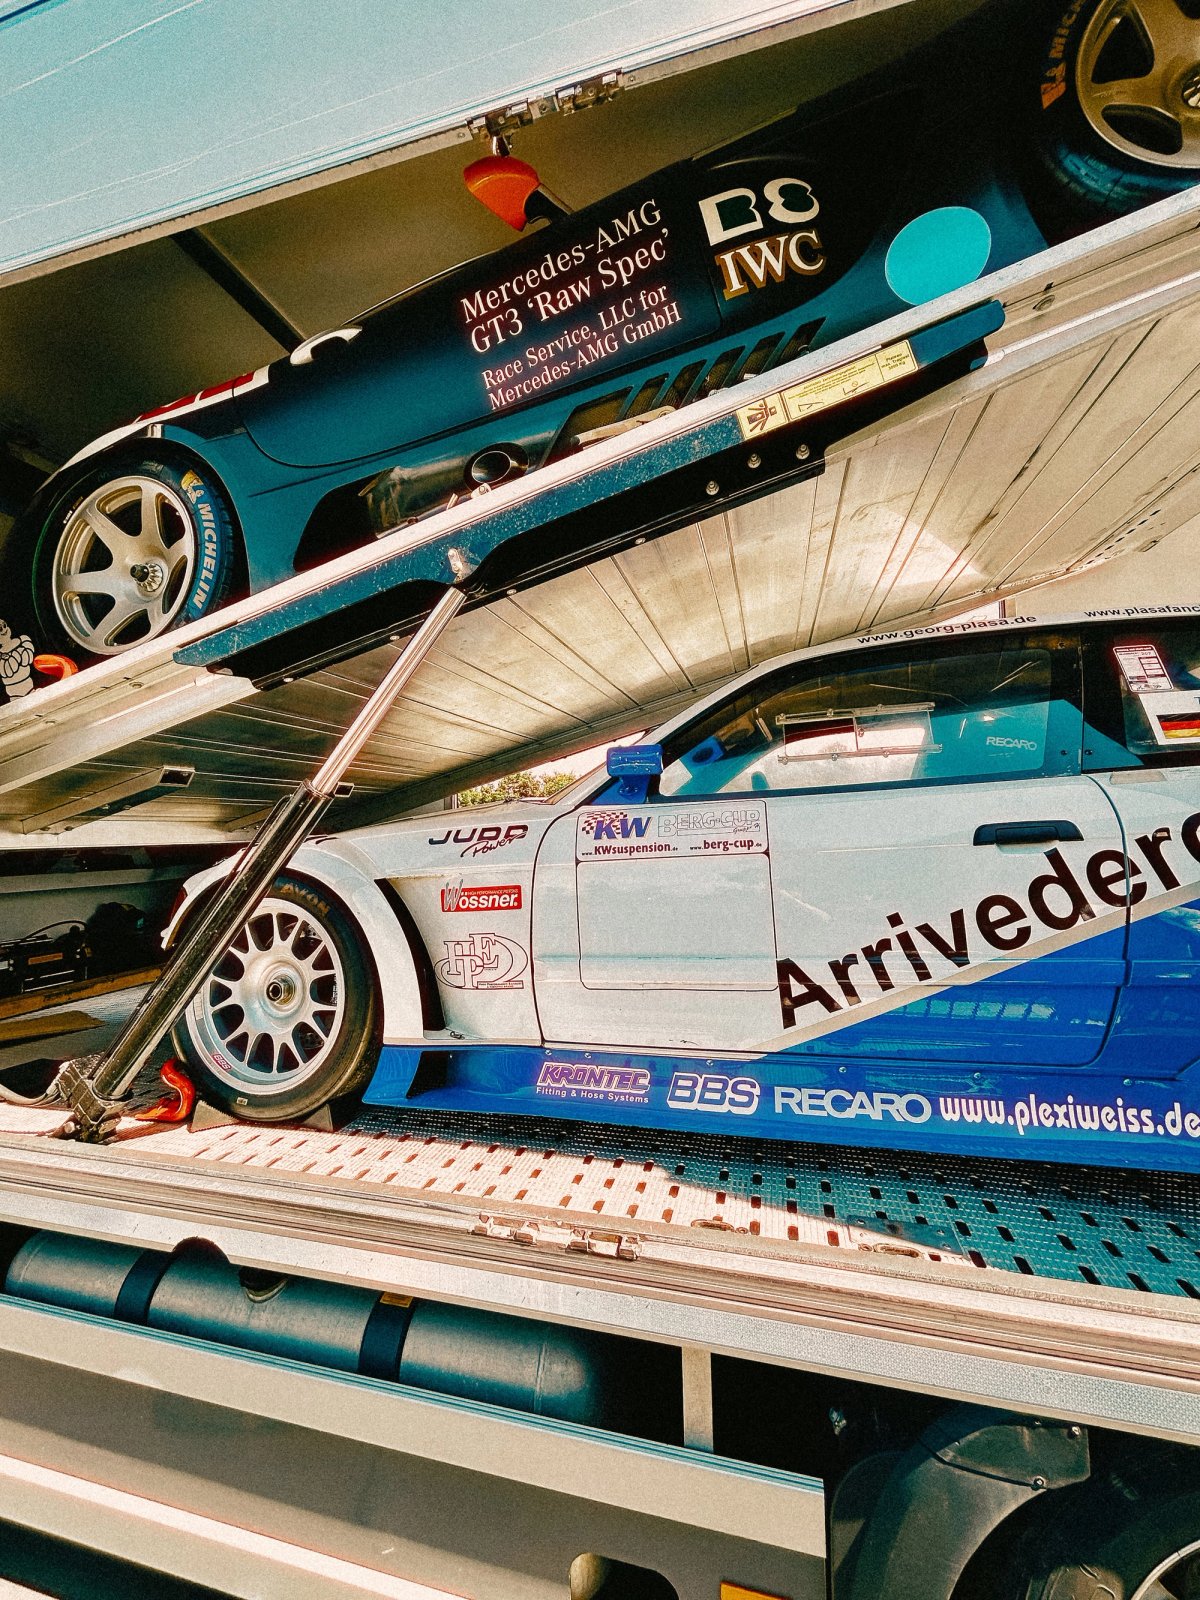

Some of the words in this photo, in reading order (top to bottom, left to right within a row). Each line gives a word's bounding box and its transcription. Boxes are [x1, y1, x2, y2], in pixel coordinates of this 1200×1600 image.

[460, 198, 662, 324] Mercedes-AMG
[717, 229, 825, 297] IWC
[471, 307, 523, 354] GT3
[481, 358, 524, 390] Race
[525, 324, 598, 367] Service,
[597, 296, 636, 332] LLC
[638, 285, 668, 311] for
[488, 332, 619, 412] Mercedes-AMG
[622, 301, 683, 344] GmbH
[192, 503, 218, 610] MICHELIN
[857, 615, 1037, 644] www.georg-plasa.de
[986, 736, 1038, 751] RECARO
[428, 825, 529, 845] JUDD
[460, 831, 527, 857] Power
[593, 816, 652, 841] KW
[581, 842, 678, 857] www.KWsuspension.de
[690, 839, 762, 851] www.berg-cup.de
[280, 882, 331, 914] AVON
[537, 1062, 650, 1094] KRONTEC
[667, 1072, 760, 1115] BBS
[536, 1087, 567, 1098] Fitting
[580, 1091, 605, 1099] Hose
[607, 1092, 649, 1103] Systems
[773, 1085, 932, 1123] RECARO
[939, 1093, 1200, 1138] www.plexiweiss.de
